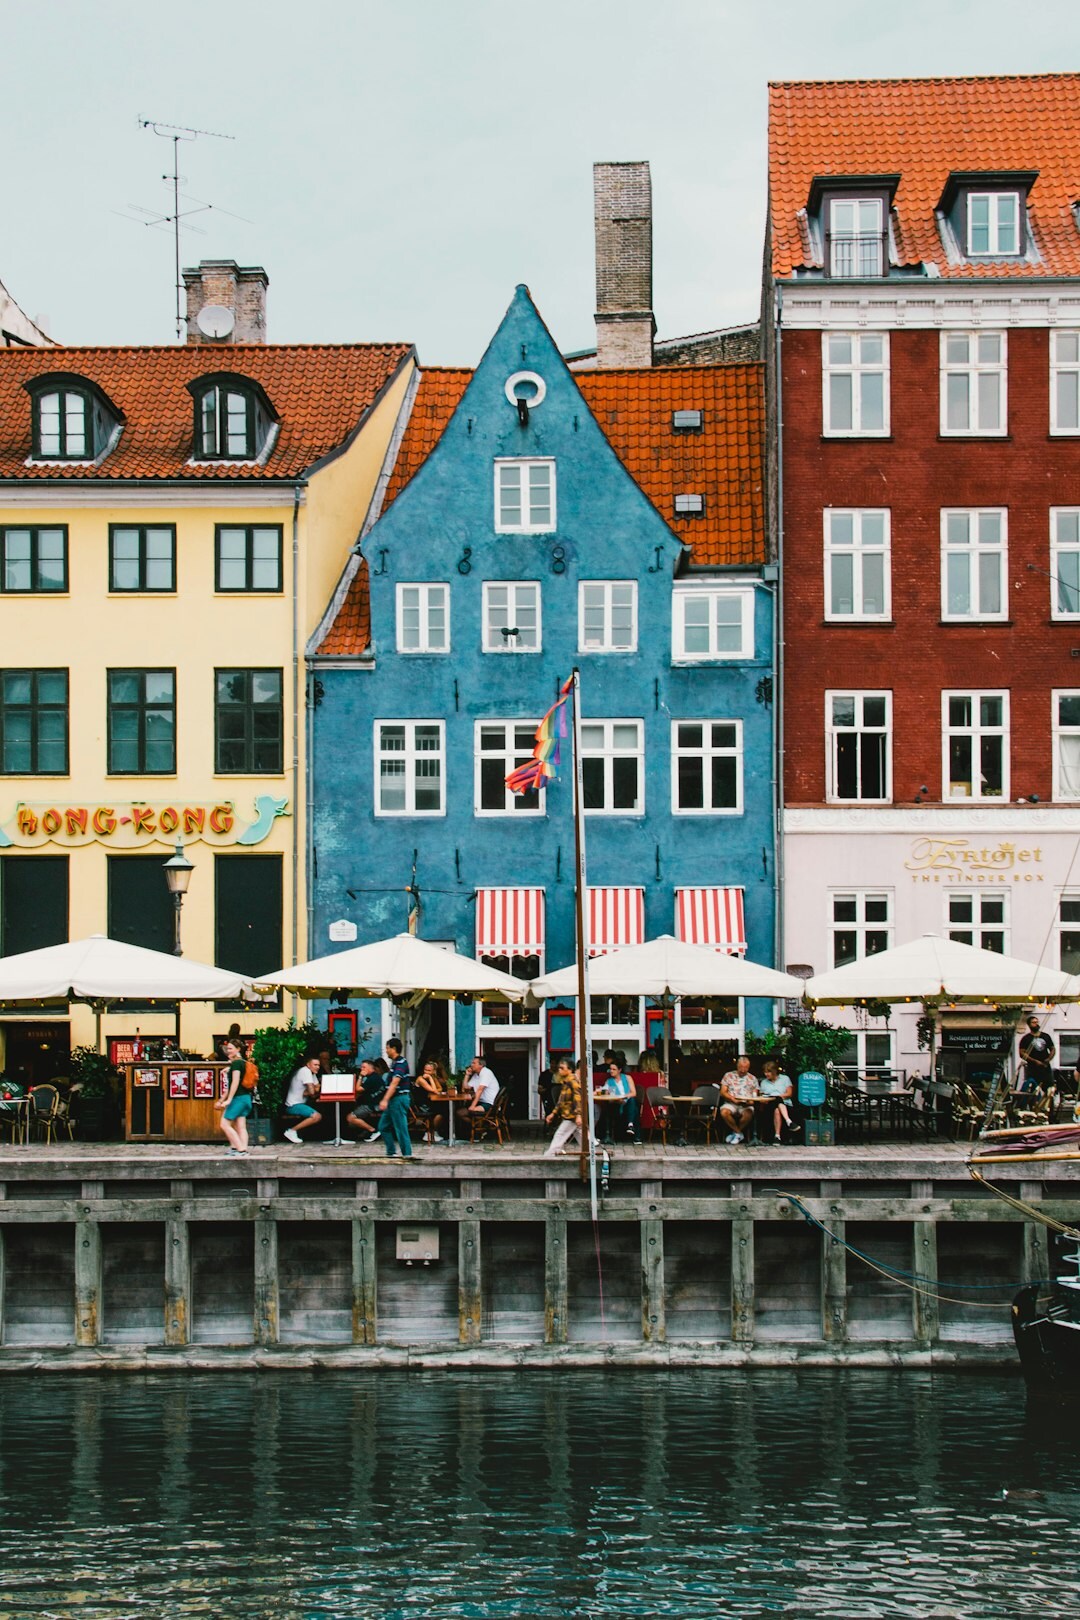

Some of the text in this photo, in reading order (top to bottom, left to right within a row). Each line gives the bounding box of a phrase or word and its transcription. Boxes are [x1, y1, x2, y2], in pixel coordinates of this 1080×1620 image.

[17, 806, 234, 835] HONG-KONG
[912, 873, 1044, 882] THE TINDER BOX
